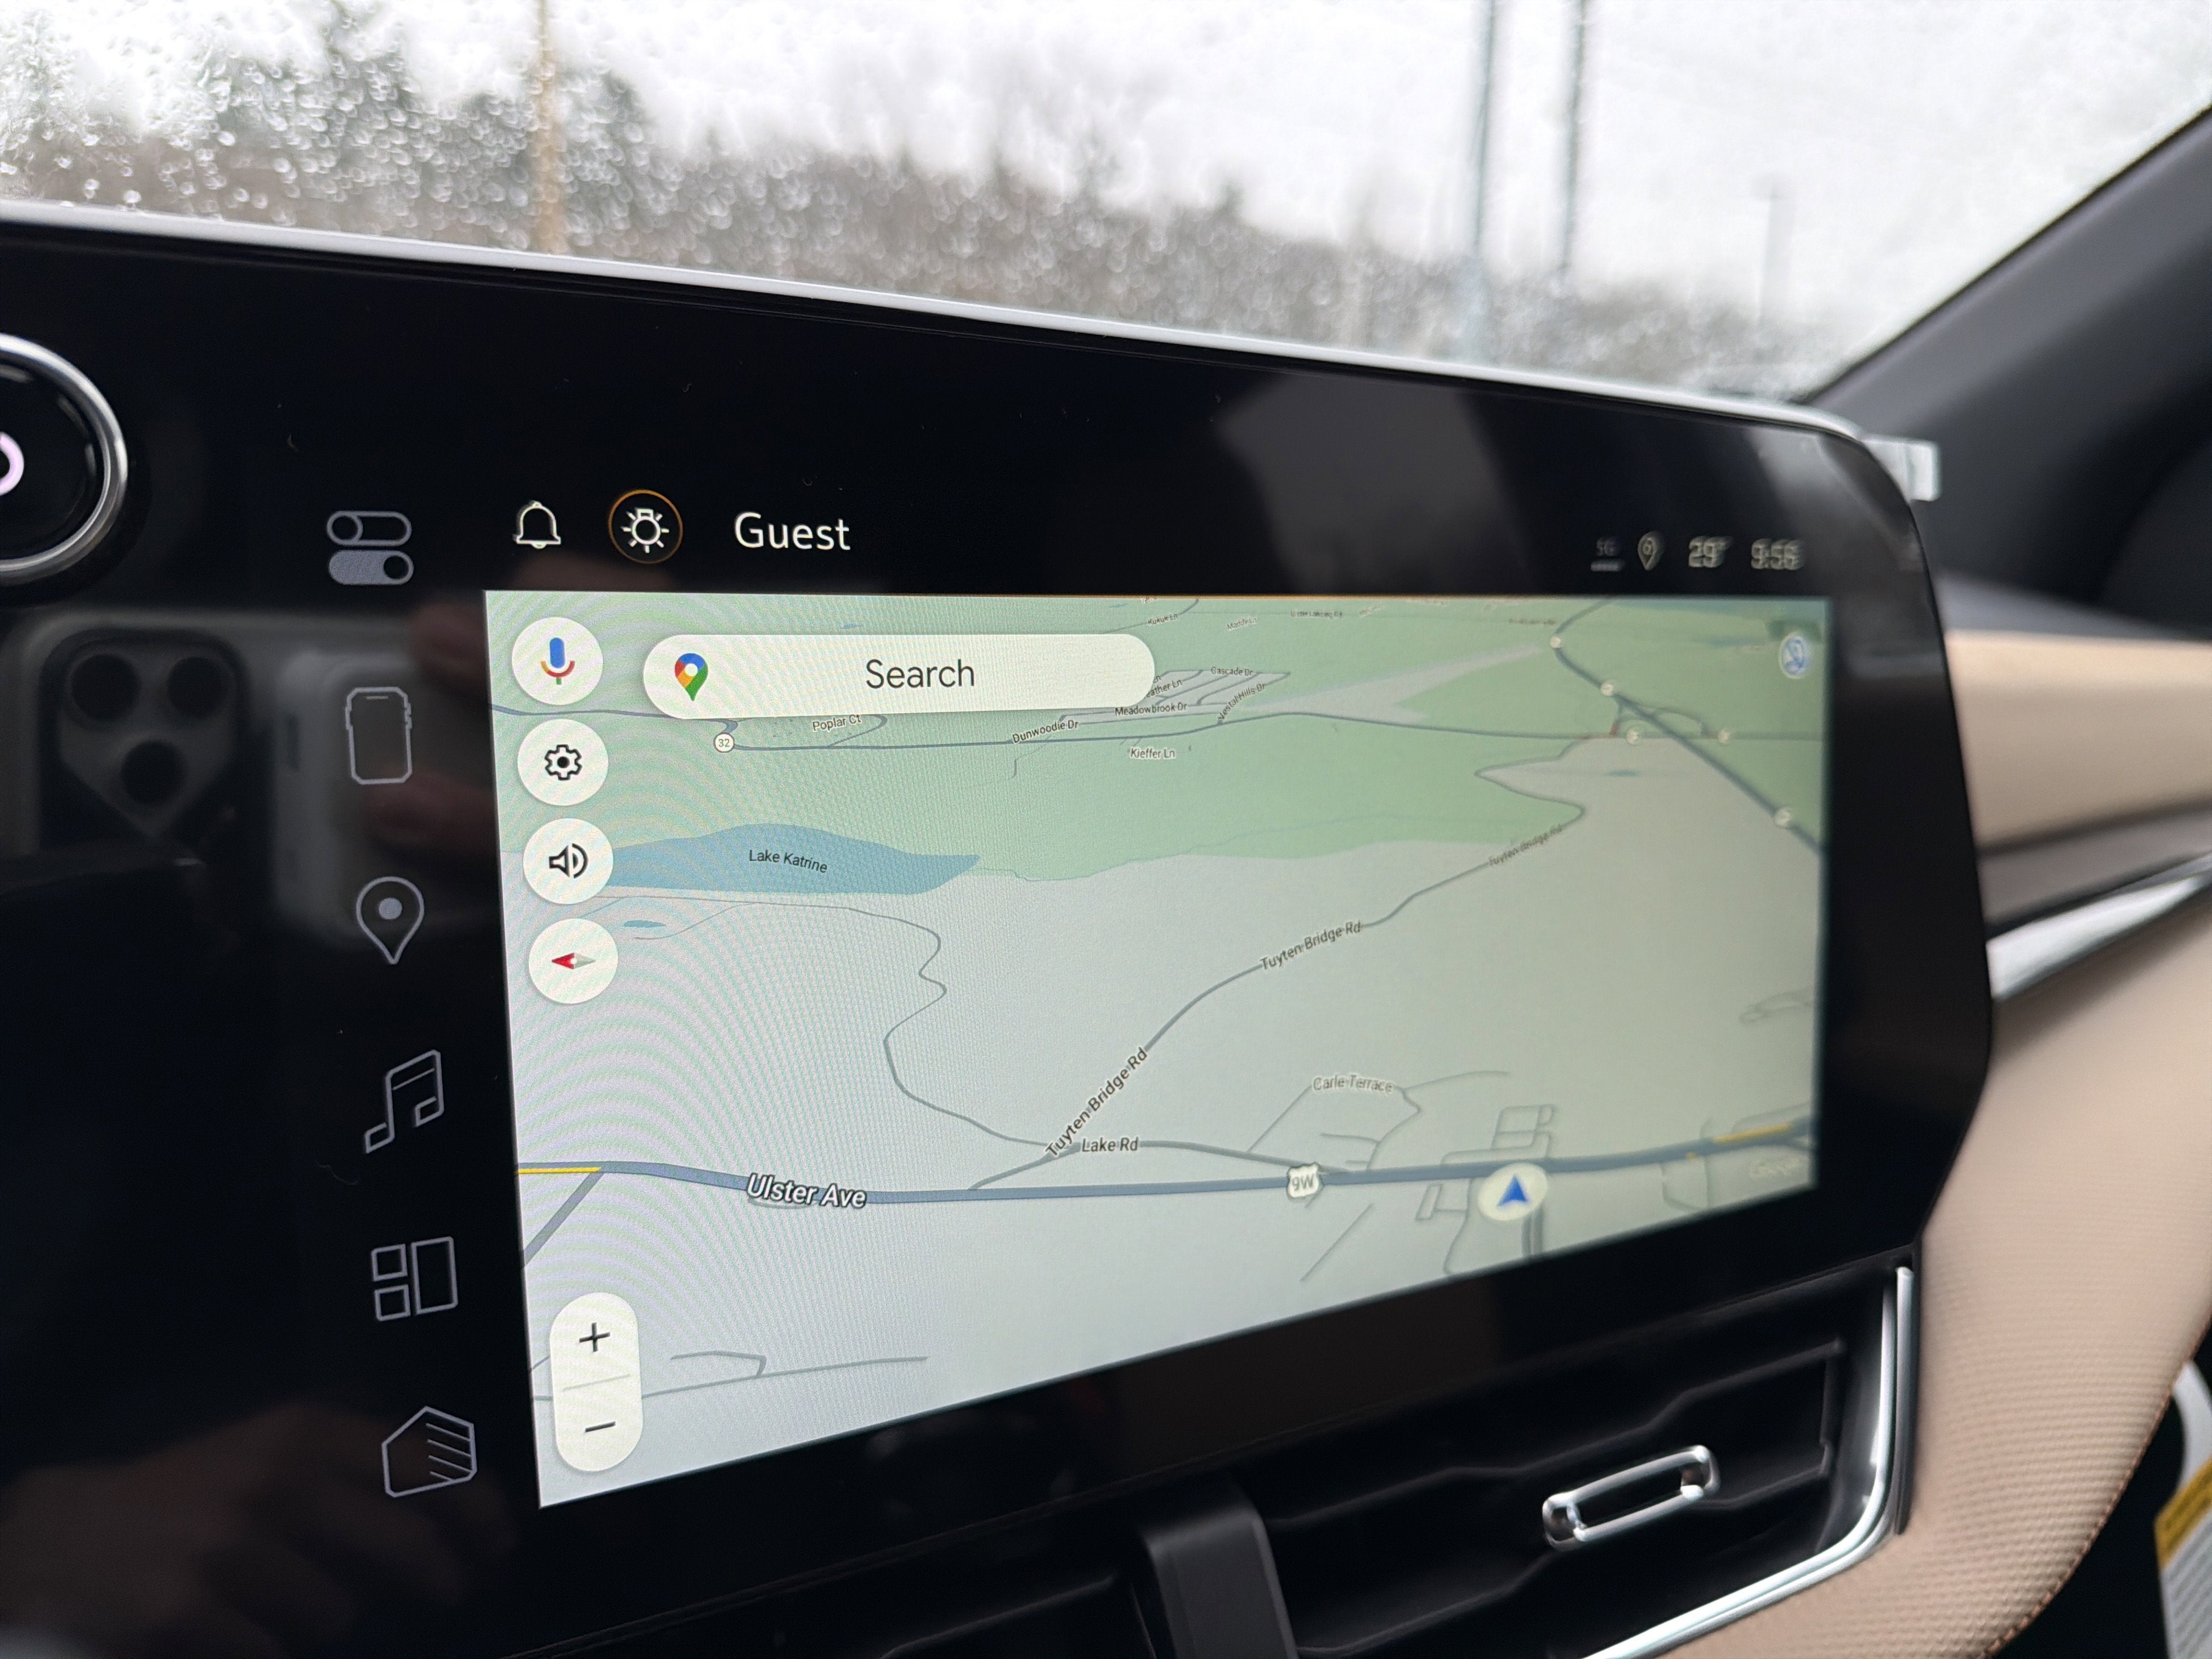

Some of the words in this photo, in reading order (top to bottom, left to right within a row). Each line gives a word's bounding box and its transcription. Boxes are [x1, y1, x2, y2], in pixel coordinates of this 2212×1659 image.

[734, 511, 851, 550] Guest
[865, 658, 975, 689] Search
[1211, 667, 1243, 675] Cascade
[1144, 683, 1170, 699] eather
[1172, 679, 1183, 689] Ln
[1115, 705, 1175, 716] Meadowbrook
[1177, 702, 1187, 711] Dr
[1217, 695, 1238, 720] Vestal
[1239, 687, 1255, 701] Hills
[1257, 683, 1266, 692] Dr
[812, 718, 846, 731] Poplar
[849, 714, 861, 724] Ct
[1012, 721, 1065, 743] Dunwoodie
[1068, 720, 1079, 729] Dr
[718, 739, 730, 747] 32
[1130, 748, 1161, 758] Kieffer
[1164, 748, 1175, 758] Ln
[749, 849, 780, 863] Lake
[783, 852, 828, 873] Katrine
[1260, 944, 1302, 970] Tuyten
[1304, 929, 1342, 950] Bridge
[1345, 920, 1361, 935] Rd
[1313, 1074, 1345, 1091] Carle
[1349, 1074, 1393, 1092] Terrace
[1045, 1110, 1091, 1156] Tuyten
[1087, 1069, 1130, 1111] Bridge
[1127, 1046, 1148, 1070] Rd
[1082, 1137, 1116, 1152] Lake
[1120, 1136, 1139, 1152] Rd
[747, 1173, 819, 1205] Ulster
[819, 1183, 867, 1209] Ave
[1292, 1173, 1314, 1192] 9W
